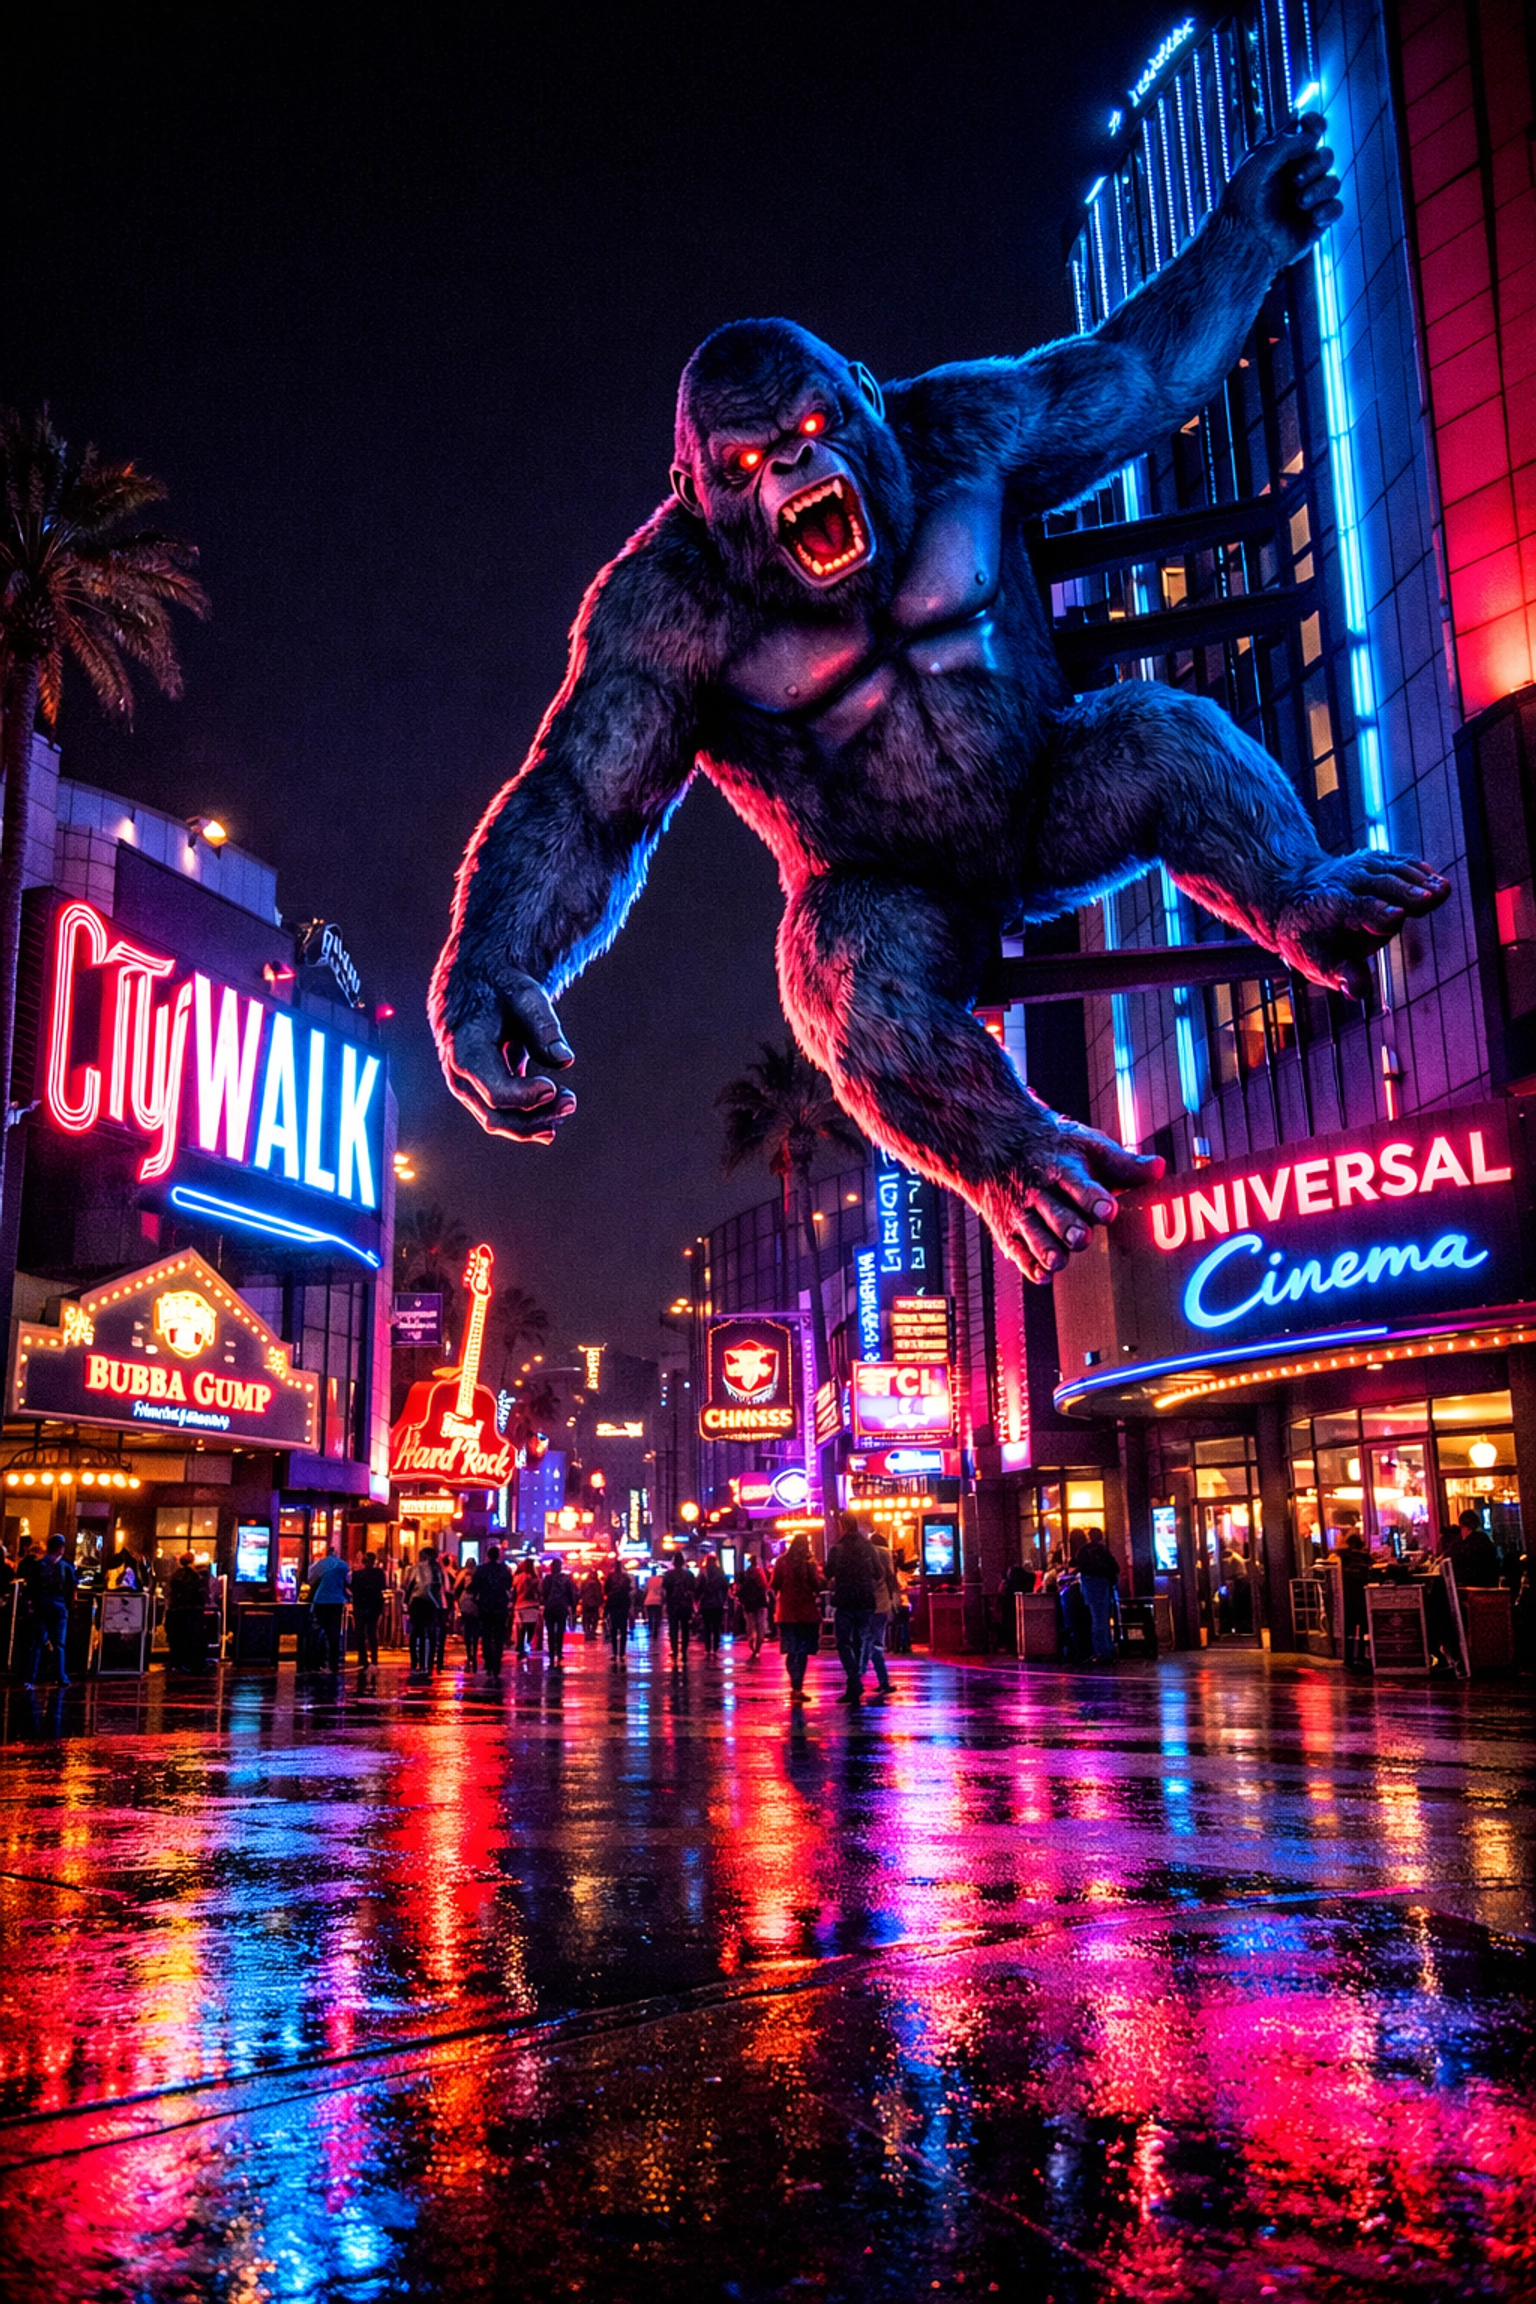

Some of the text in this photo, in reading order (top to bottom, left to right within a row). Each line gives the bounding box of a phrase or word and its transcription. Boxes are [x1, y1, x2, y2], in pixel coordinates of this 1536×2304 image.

[1151, 1131, 1513, 1250] UNIVERSAL
[1184, 1233, 1490, 1329] Cinema
[86, 1354, 272, 1413] BUBBA GUMP
[392, 1427, 511, 1479] Hard Rock
